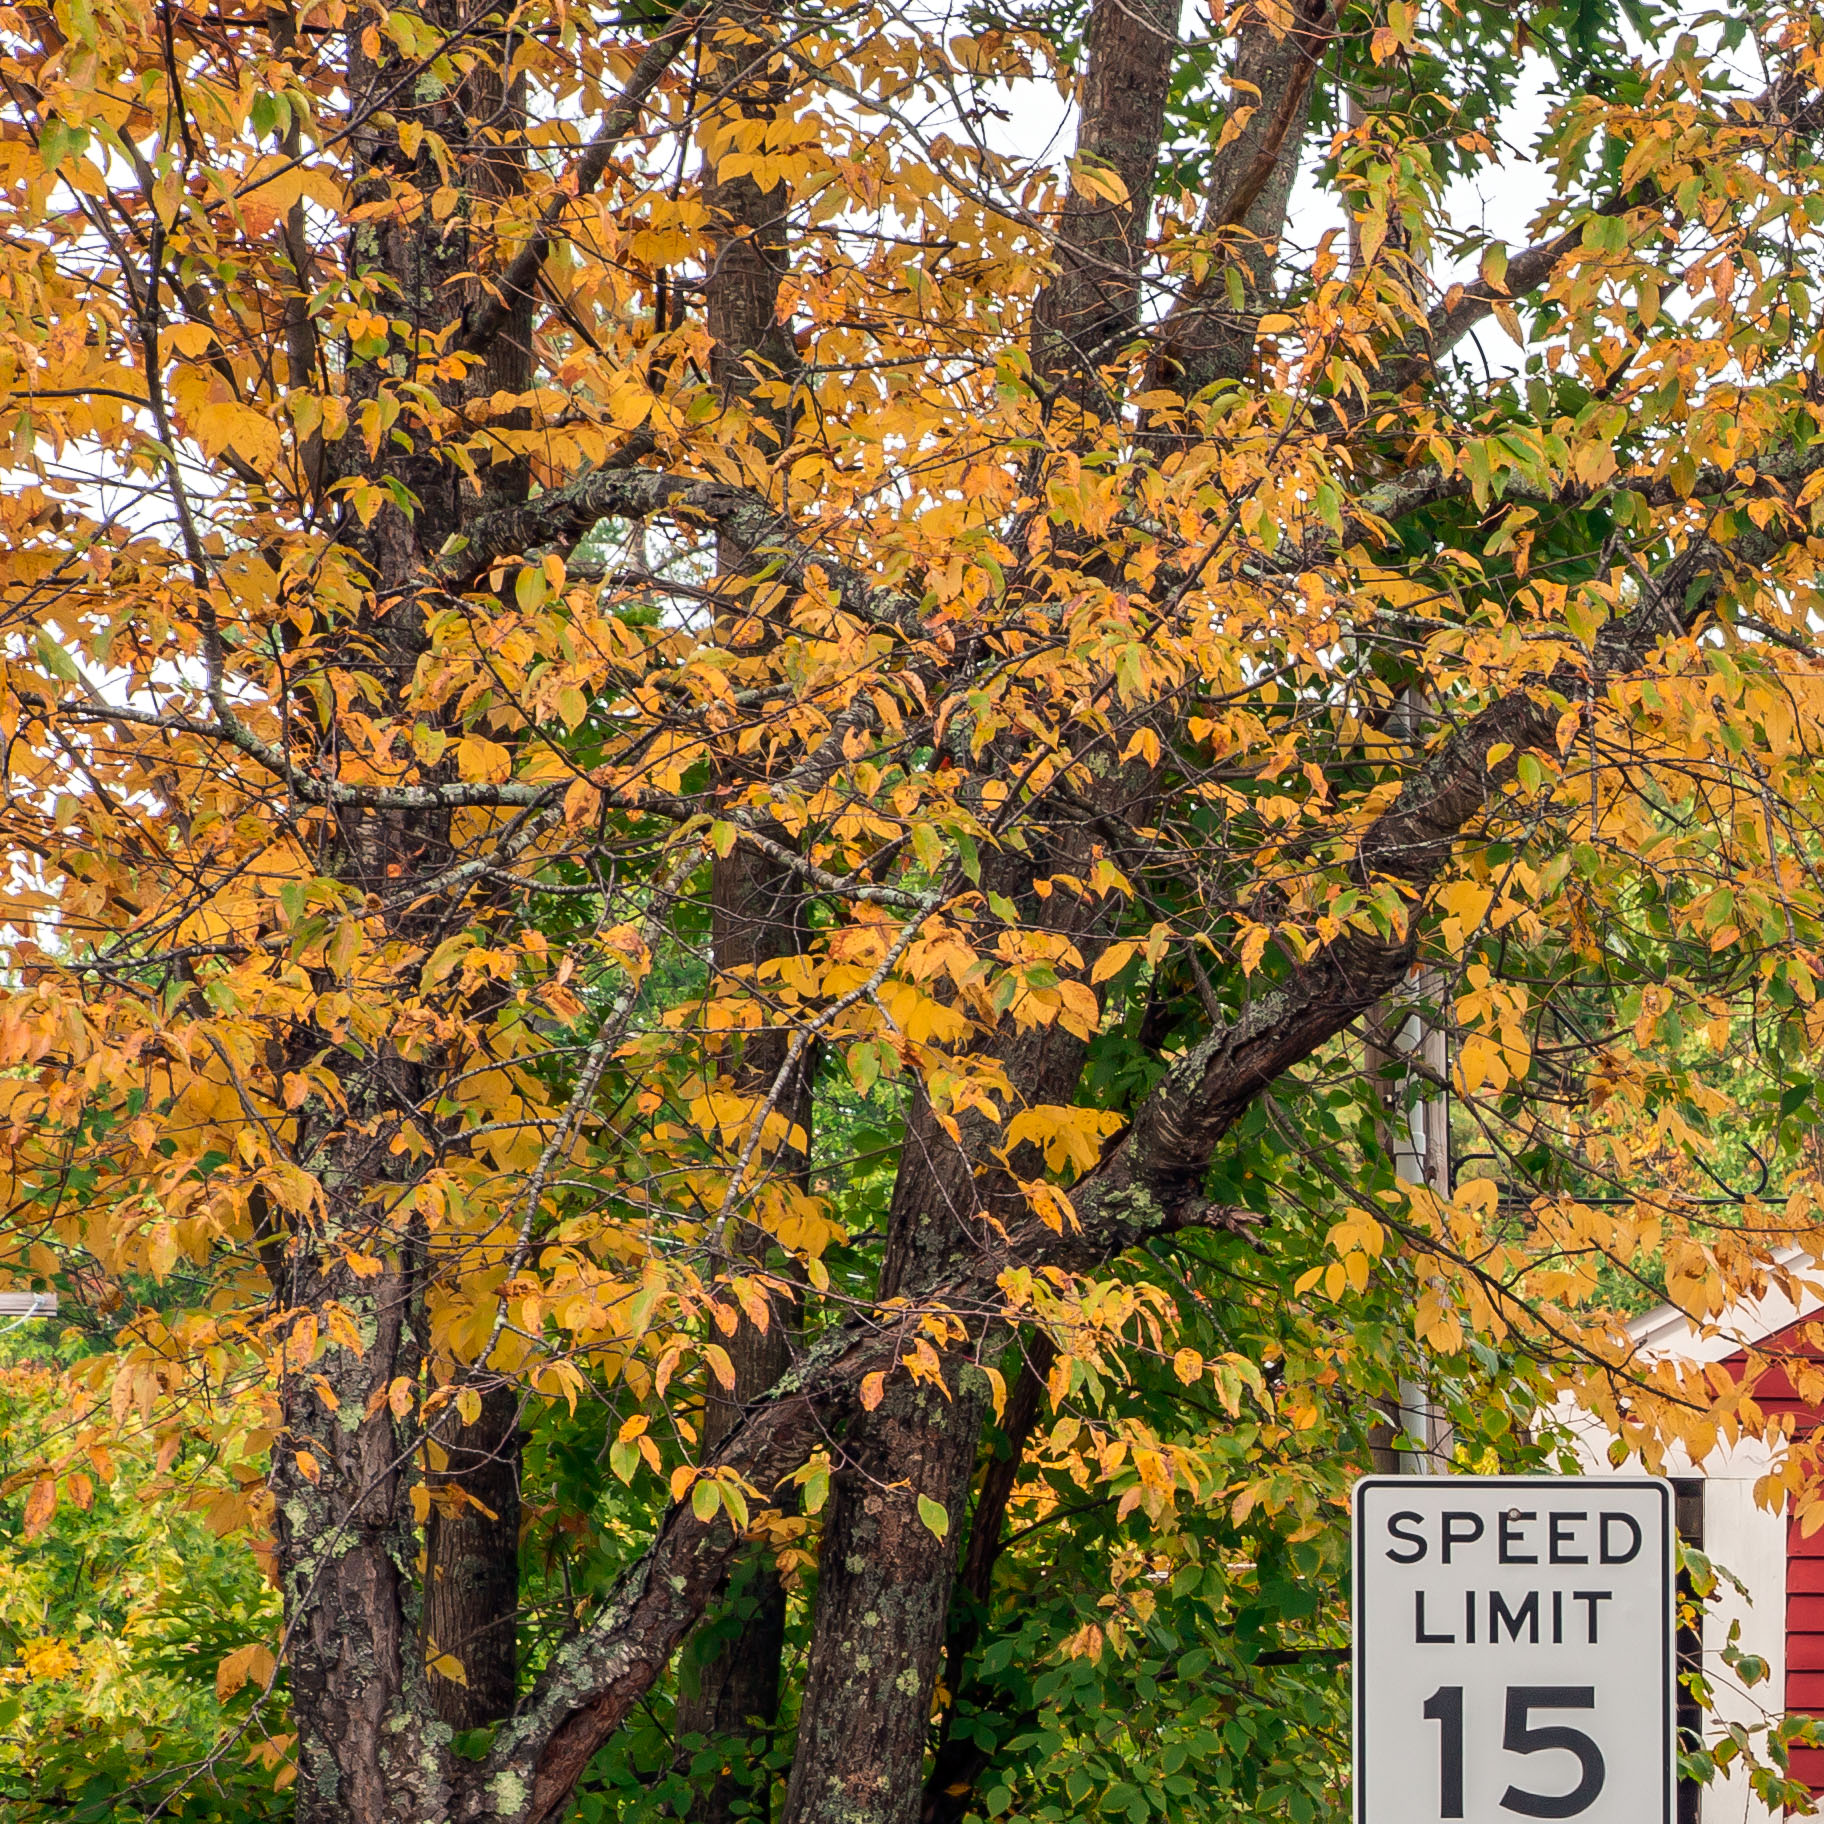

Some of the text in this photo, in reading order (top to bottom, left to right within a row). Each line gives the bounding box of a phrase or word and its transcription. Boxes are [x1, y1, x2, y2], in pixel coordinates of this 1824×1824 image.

[1385, 1507, 1642, 1565] SPEED
[1415, 1590, 1613, 1644] LIMIT
[1423, 1685, 1606, 1819] 15
